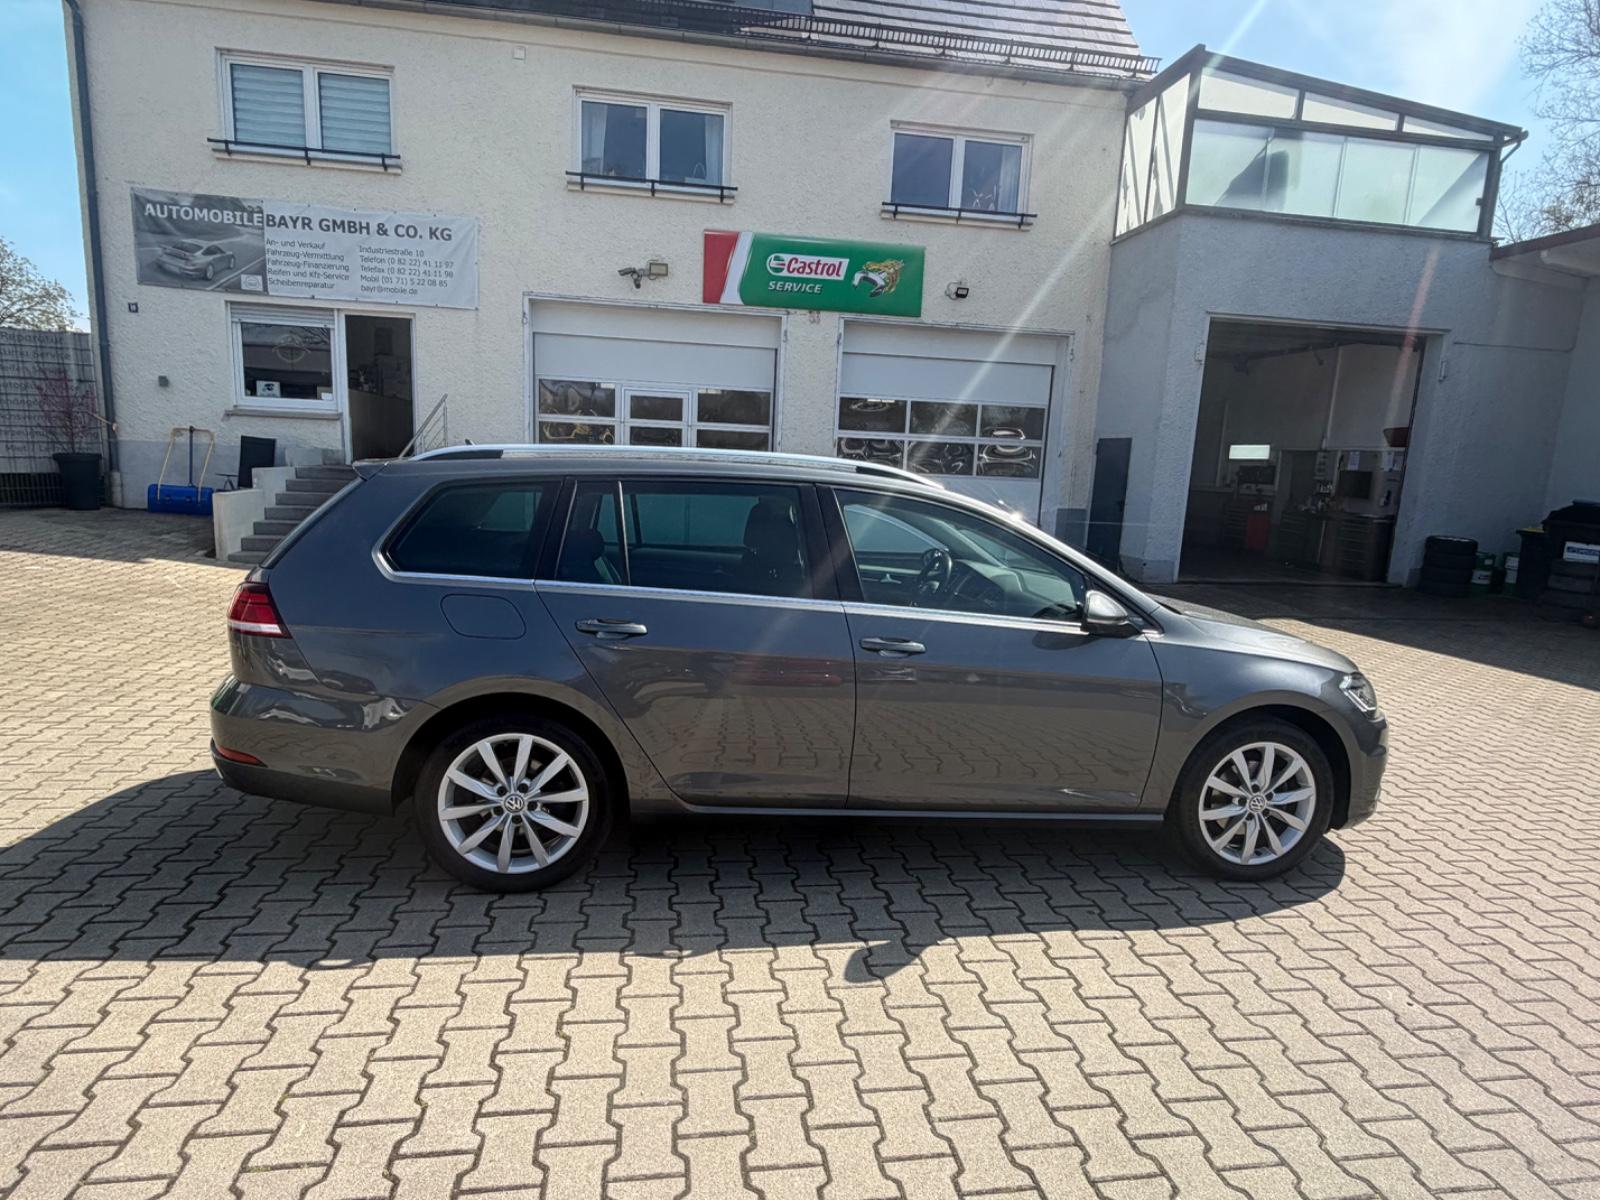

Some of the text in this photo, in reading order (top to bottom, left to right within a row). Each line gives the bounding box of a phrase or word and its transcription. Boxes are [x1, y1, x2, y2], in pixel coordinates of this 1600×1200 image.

[144, 203, 453, 242] AUTOMOBILE BAYR GMBH & CO. KG
[281, 239, 295, 248] und
[297, 240, 326, 250] Verkauf
[359, 245, 425, 258] Industriestraße 10
[267, 258, 350, 272] Fahrzeug-Finanzierung
[360, 254, 386, 264] Telefon
[387, 256, 395, 266] (0
[408, 258, 420, 267] 22)
[267, 267, 291, 277] Reifen
[293, 269, 307, 278] und
[360, 264, 385, 274] Telefax
[387, 266, 395, 276] (0
[408, 268, 420, 277] 22)
[786, 257, 843, 278] Castrol
[268, 277, 336, 289] Scheibenreparatur
[360, 273, 380, 283] Mobil
[416, 278, 426, 287] 22
[768, 281, 822, 294] SERVICE
